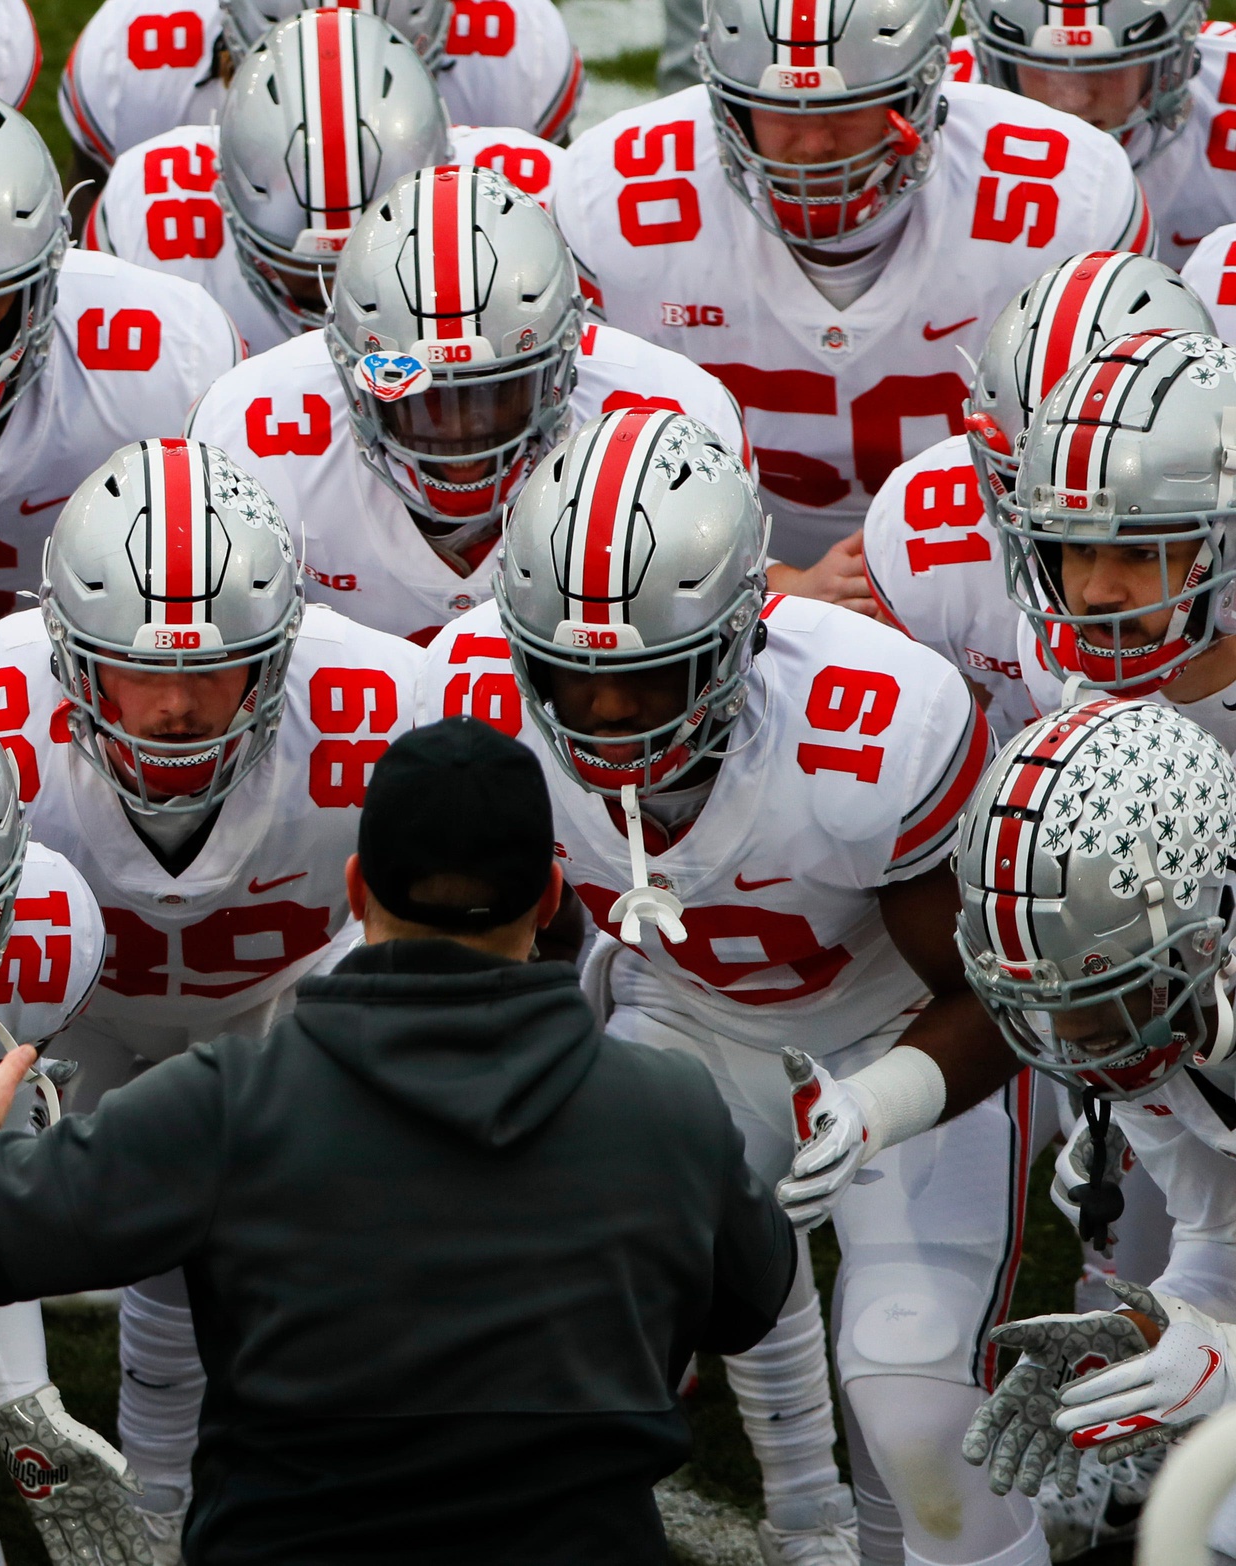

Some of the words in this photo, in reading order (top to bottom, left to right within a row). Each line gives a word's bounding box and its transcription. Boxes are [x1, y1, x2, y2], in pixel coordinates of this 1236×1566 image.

[128, 11, 204, 70] 8
[444, 0, 516, 57] 8
[144, 143, 224, 260] 28
[614, 120, 702, 247] 50
[970, 122, 1070, 248] 50
[77, 308, 161, 371] 6
[245, 394, 332, 458] 3
[904, 465, 991, 577] 81
[797, 665, 901, 785] 19
